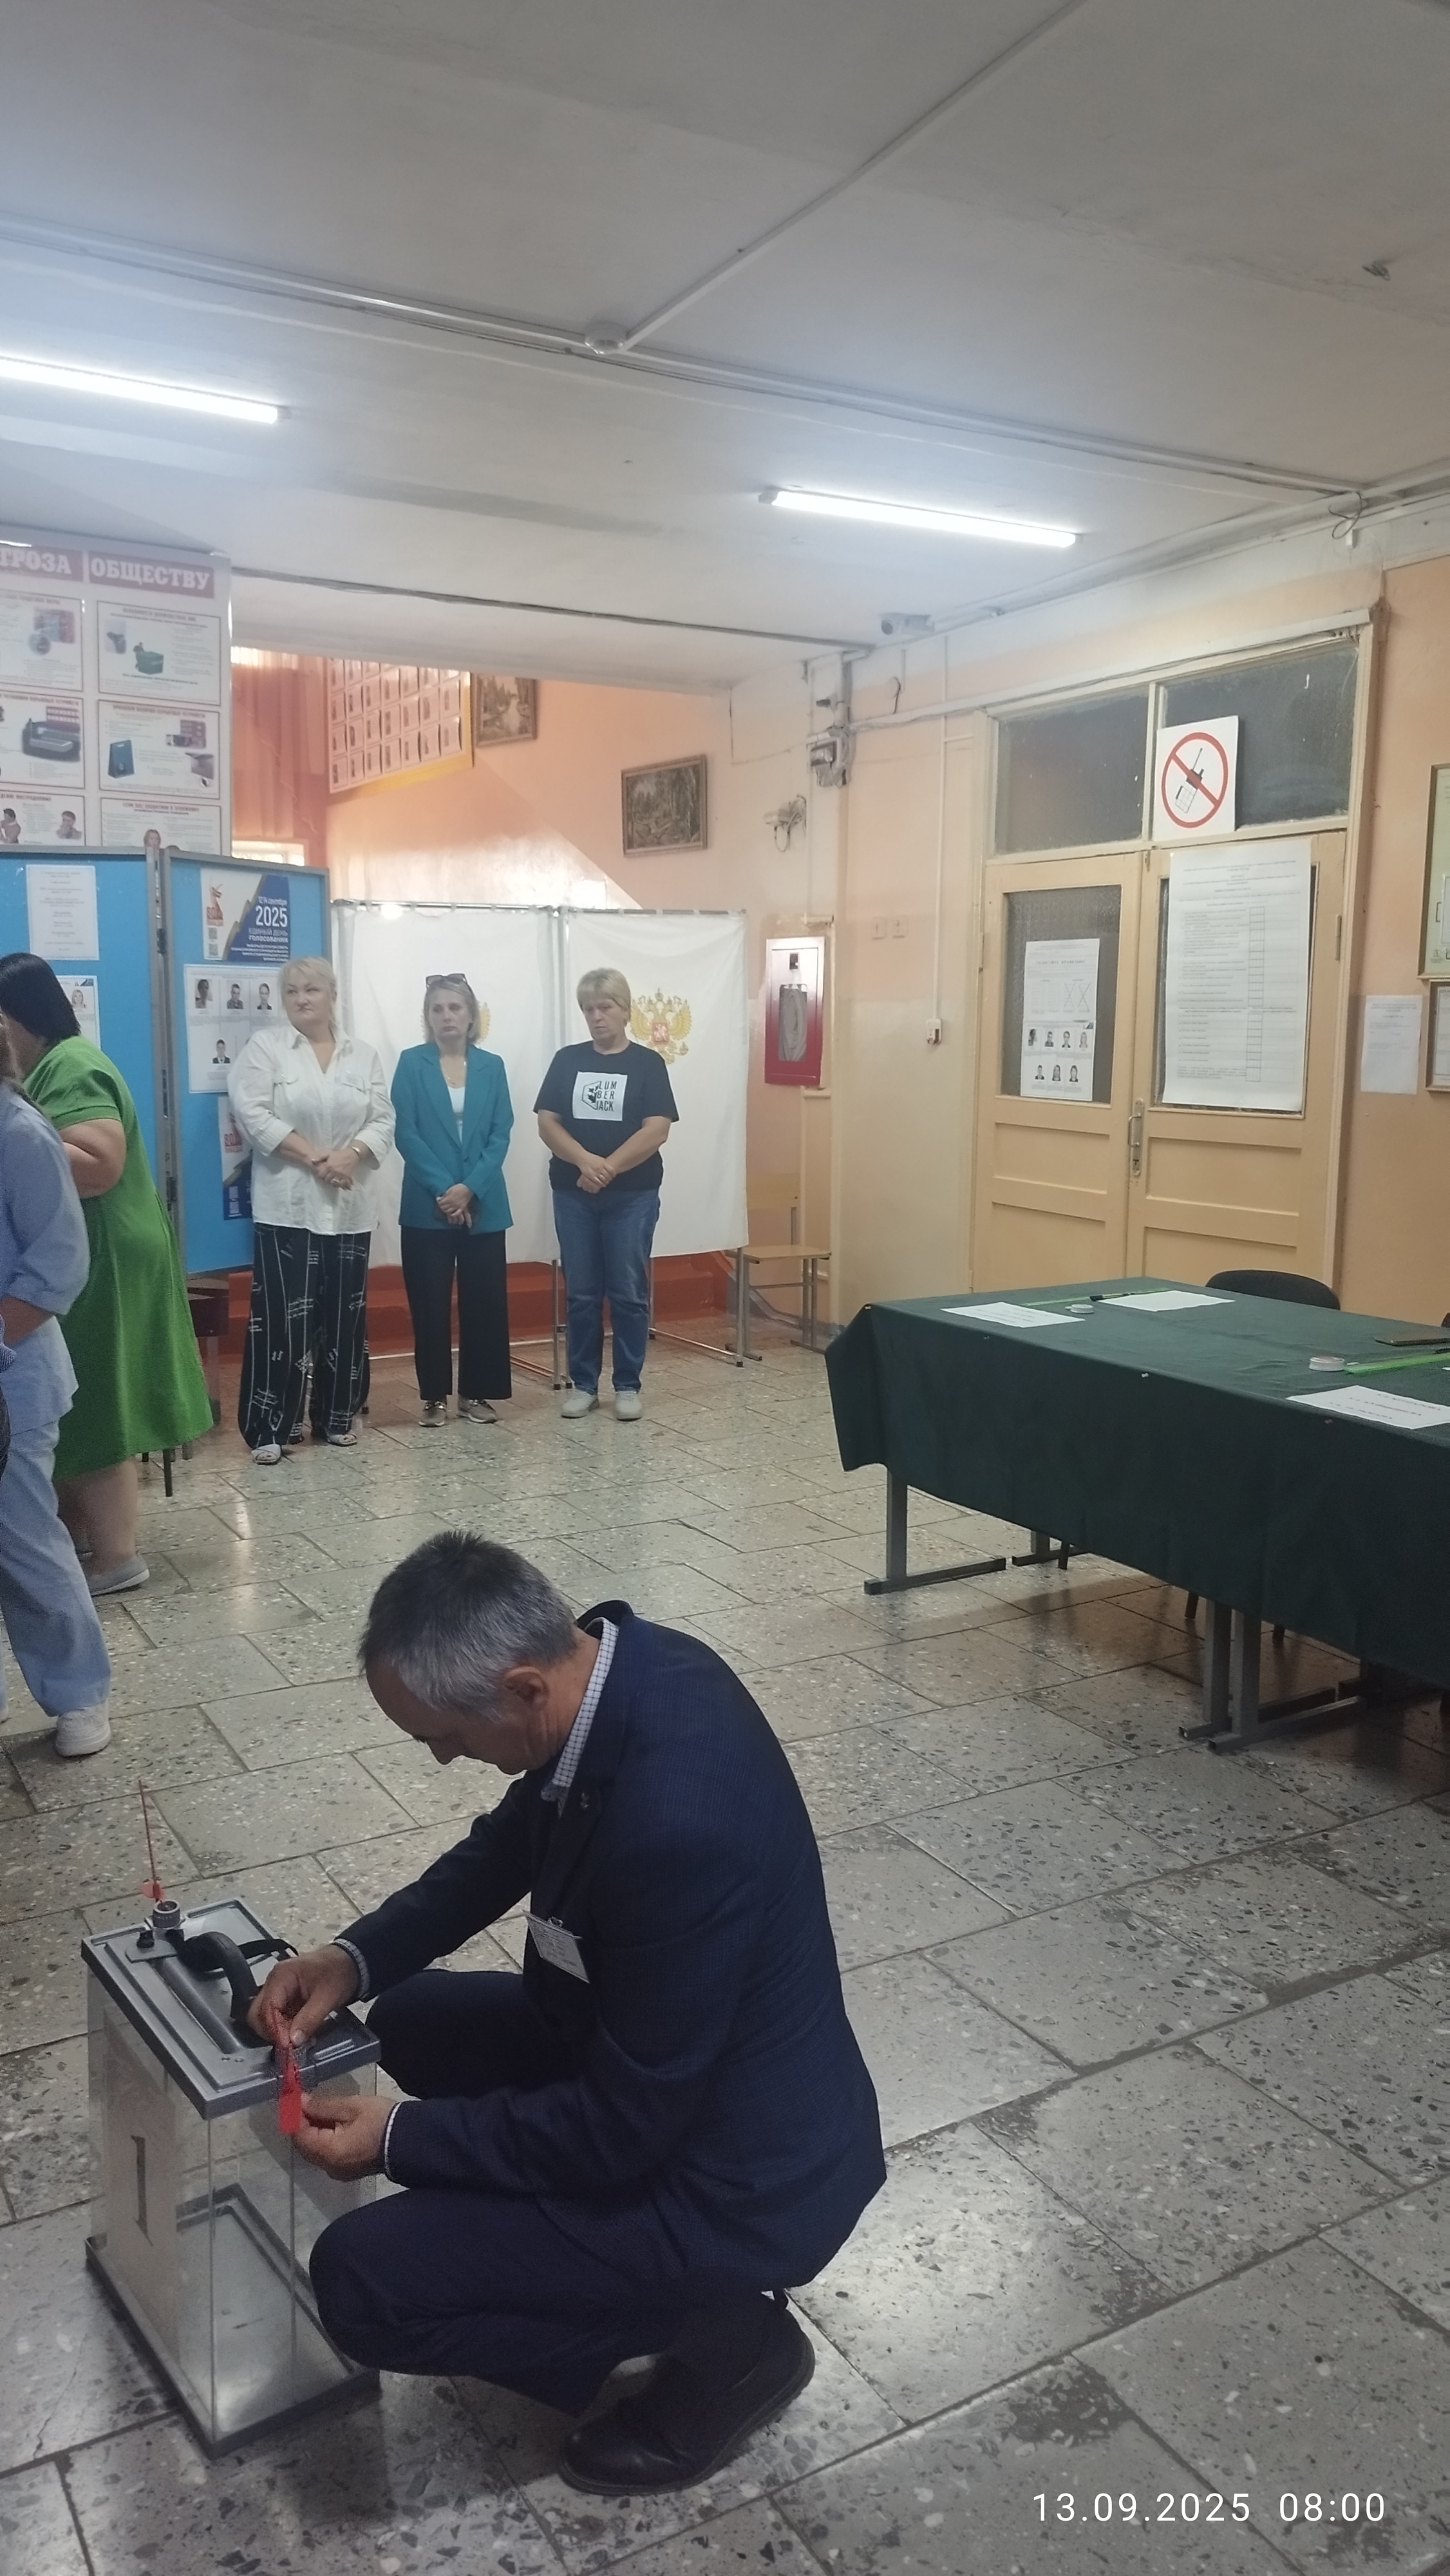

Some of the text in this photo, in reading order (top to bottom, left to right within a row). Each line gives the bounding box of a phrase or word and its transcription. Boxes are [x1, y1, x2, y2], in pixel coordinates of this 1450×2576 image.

[90, 557, 210, 591] ОБЩЕСТВУ
[256, 905, 288, 927] 2025
[598, 1081, 617, 1090] LUM
[596, 1090, 615, 1100] BER
[596, 1100, 614, 1112] JACK
